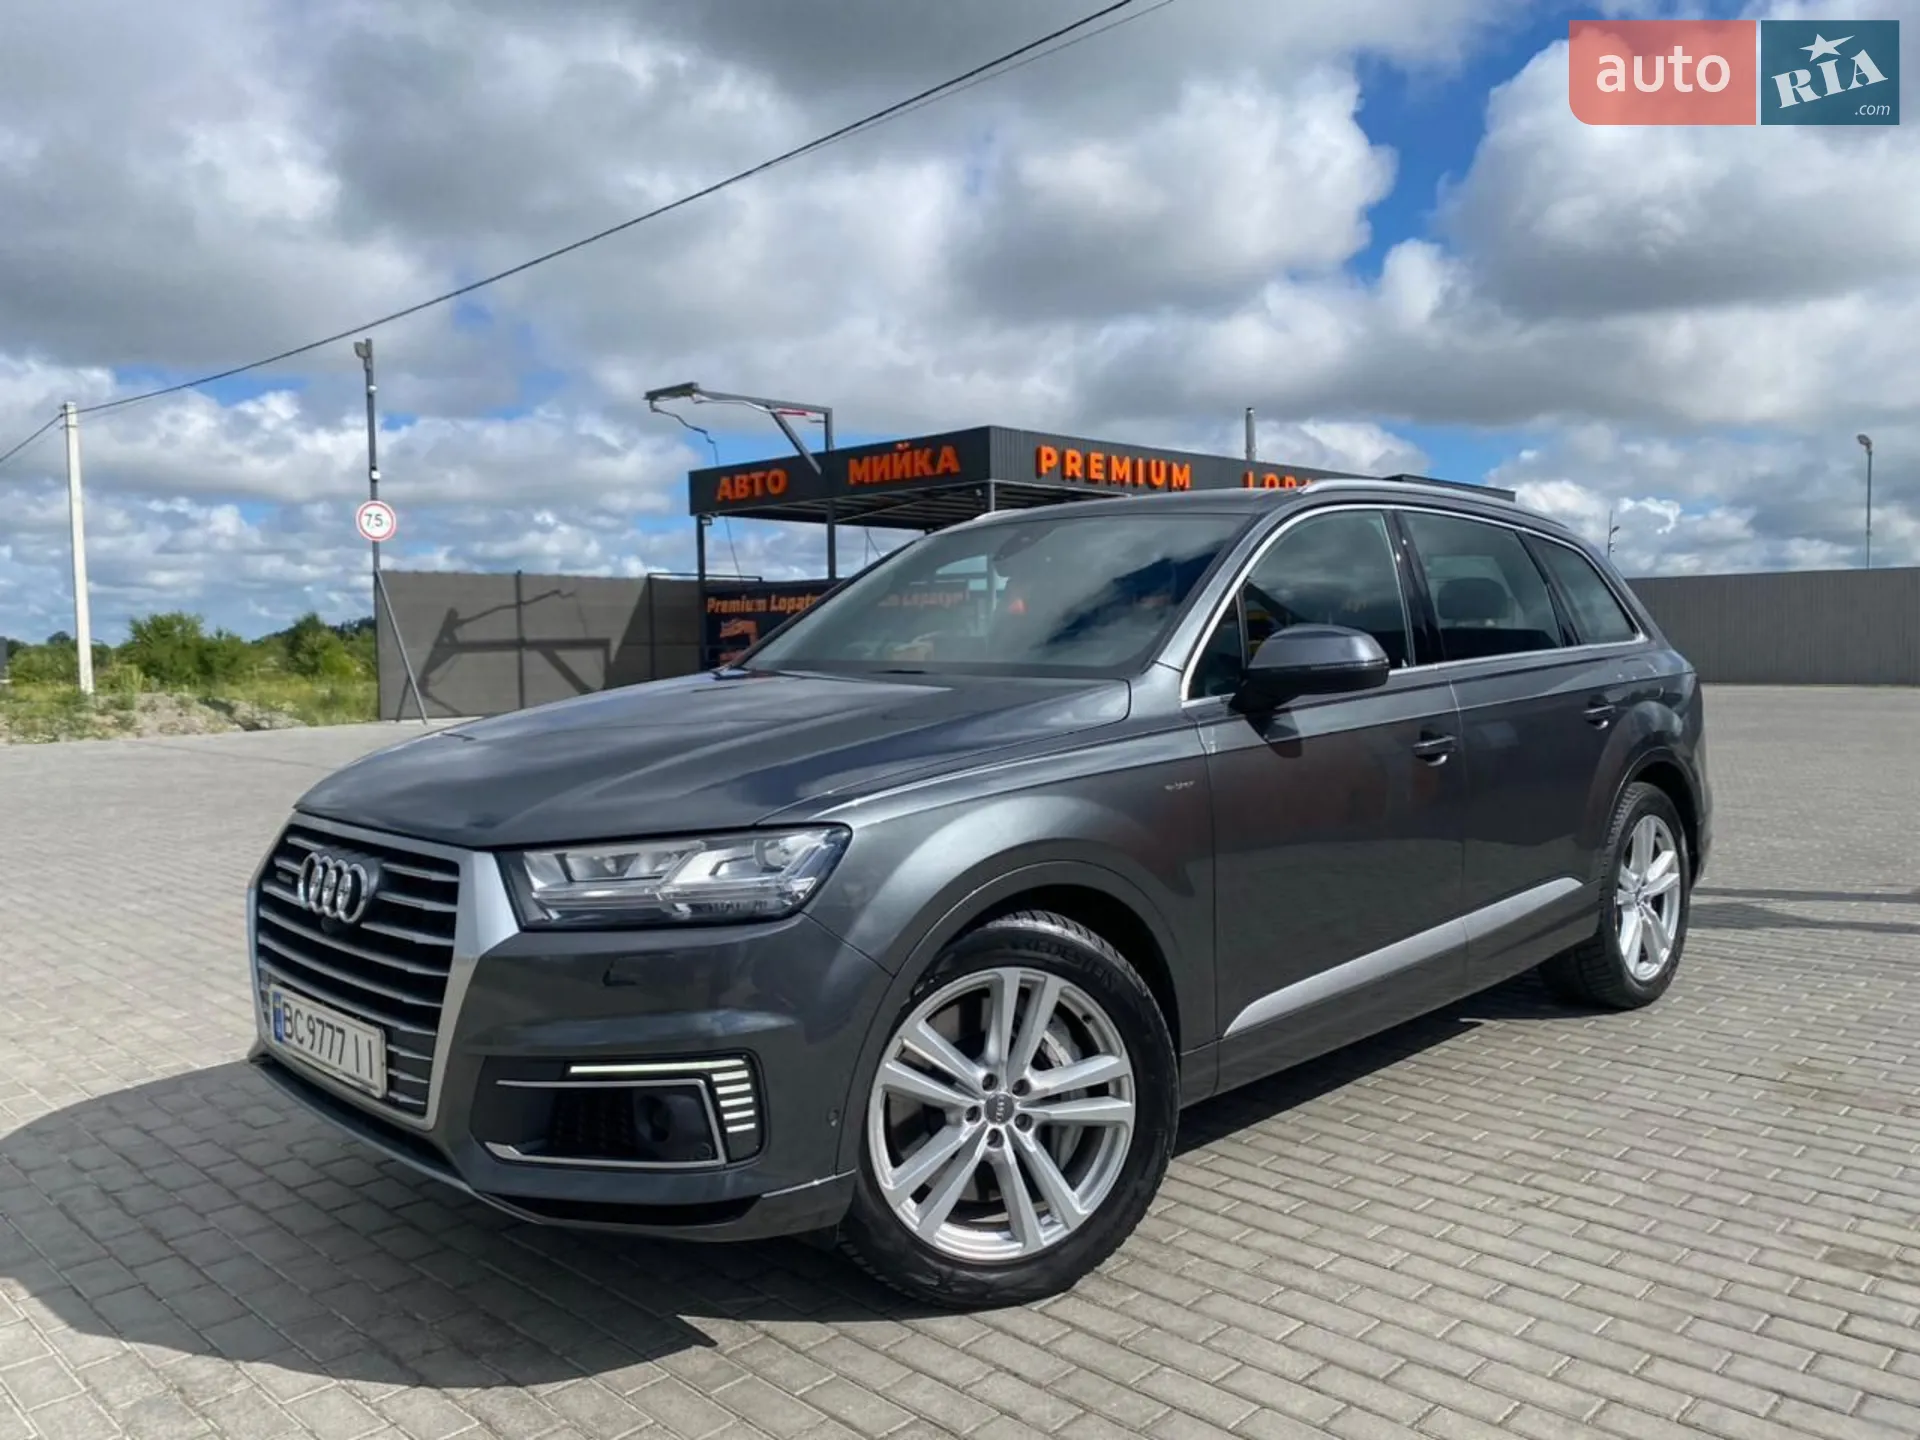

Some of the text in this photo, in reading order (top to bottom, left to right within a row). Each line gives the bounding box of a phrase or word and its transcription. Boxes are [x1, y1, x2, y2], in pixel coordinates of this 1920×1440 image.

[717, 442, 961, 501] АВТО МИЙКА
[1034, 444, 1192, 490] PREMIUM
[707, 594, 767, 614] Premium
